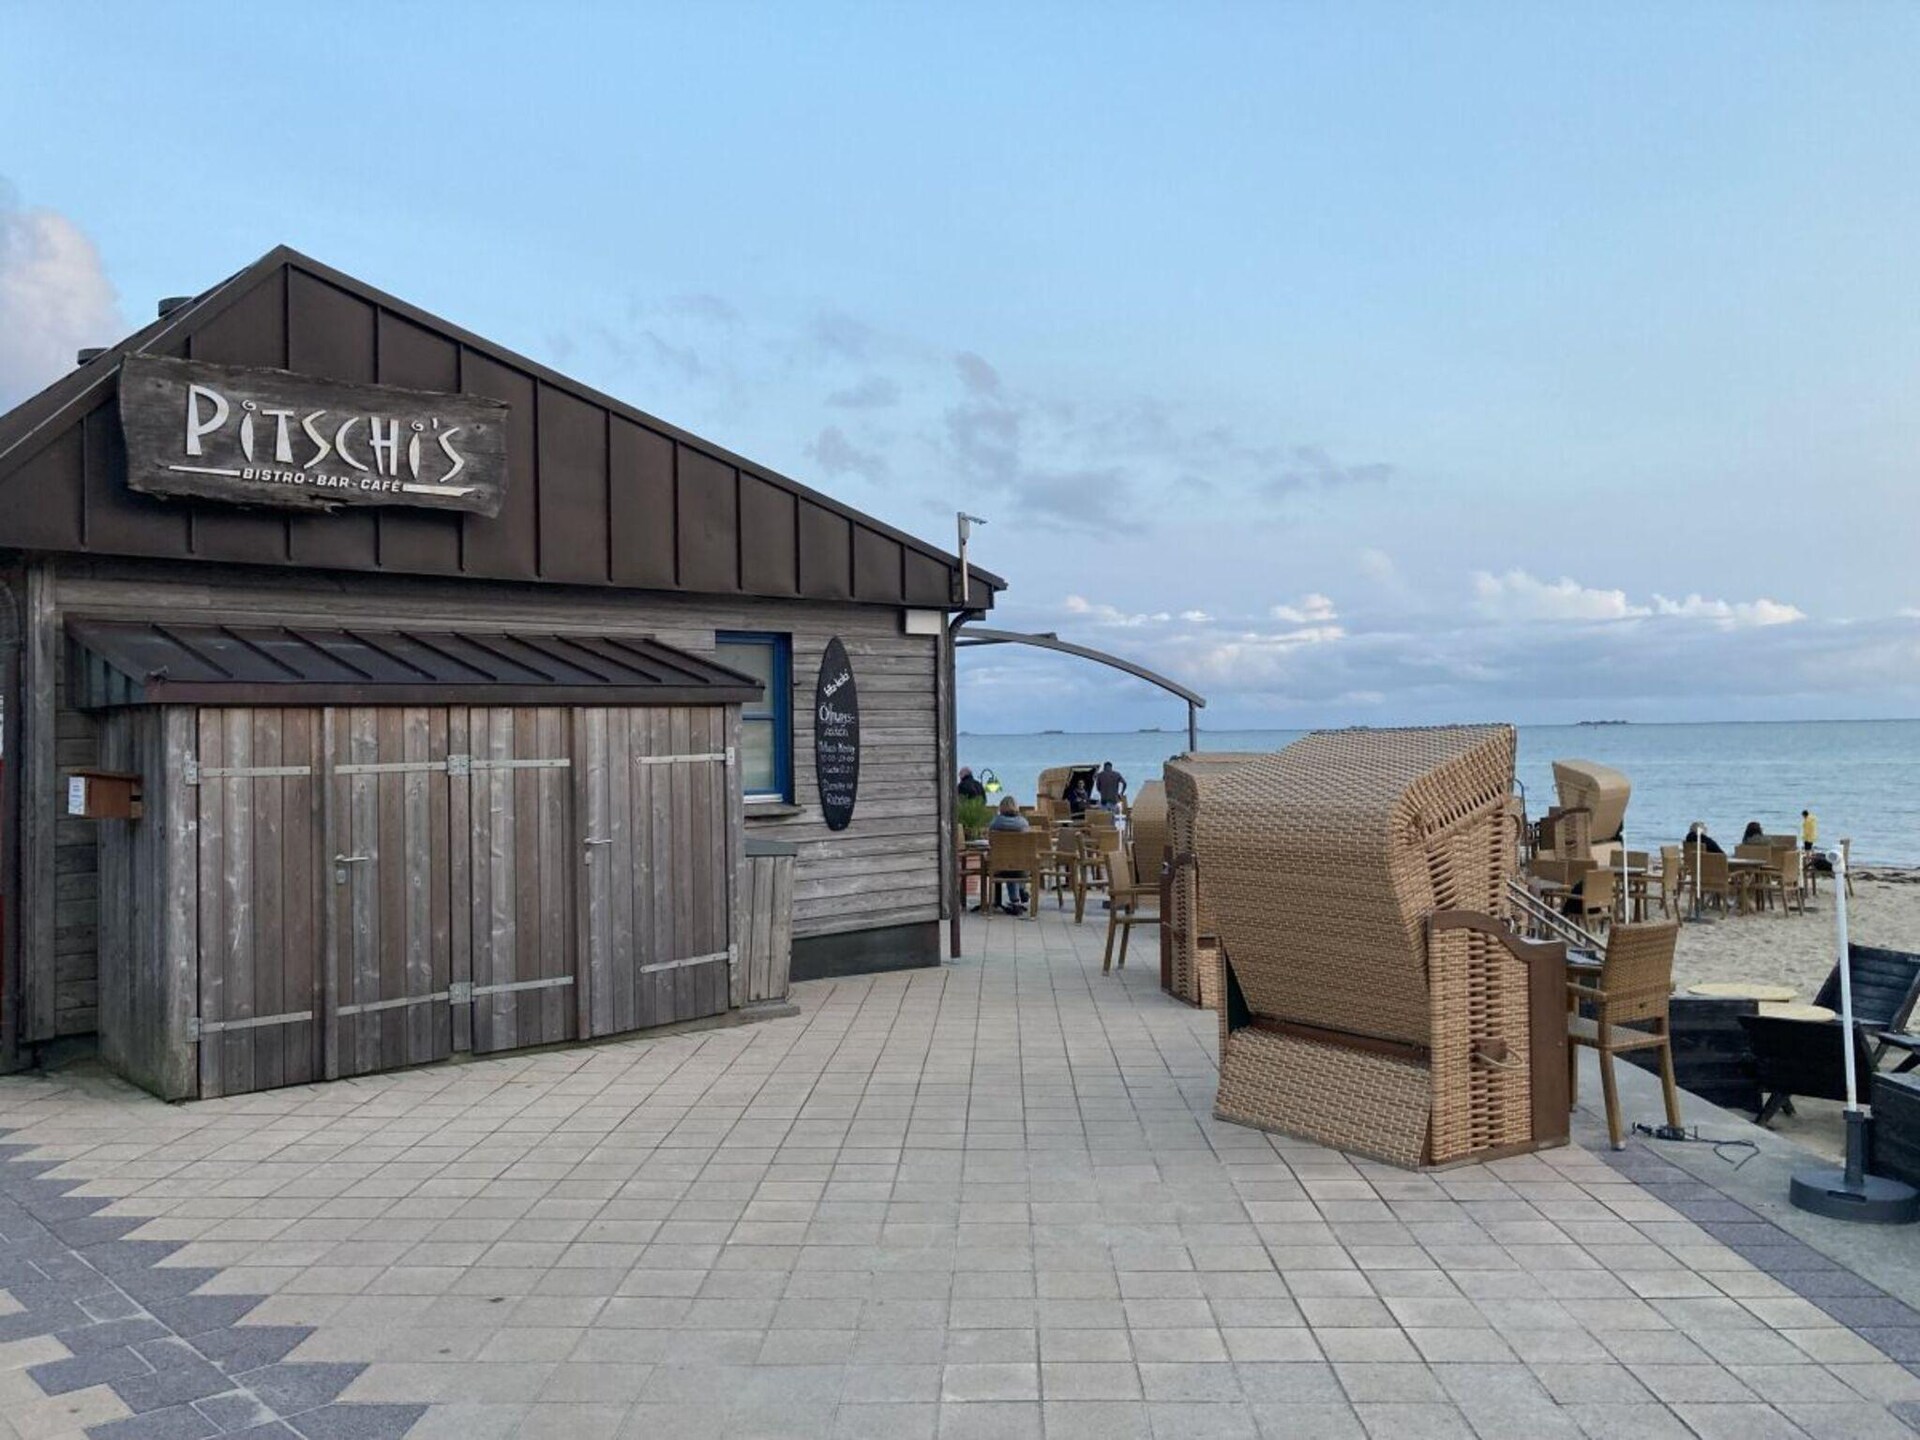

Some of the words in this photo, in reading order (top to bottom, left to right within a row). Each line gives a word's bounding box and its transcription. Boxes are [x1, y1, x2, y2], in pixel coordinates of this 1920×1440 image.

[243, 468, 305, 484] BISTRO
[316, 474, 350, 488] BAR
[360, 479, 400, 493] CAFÉ
